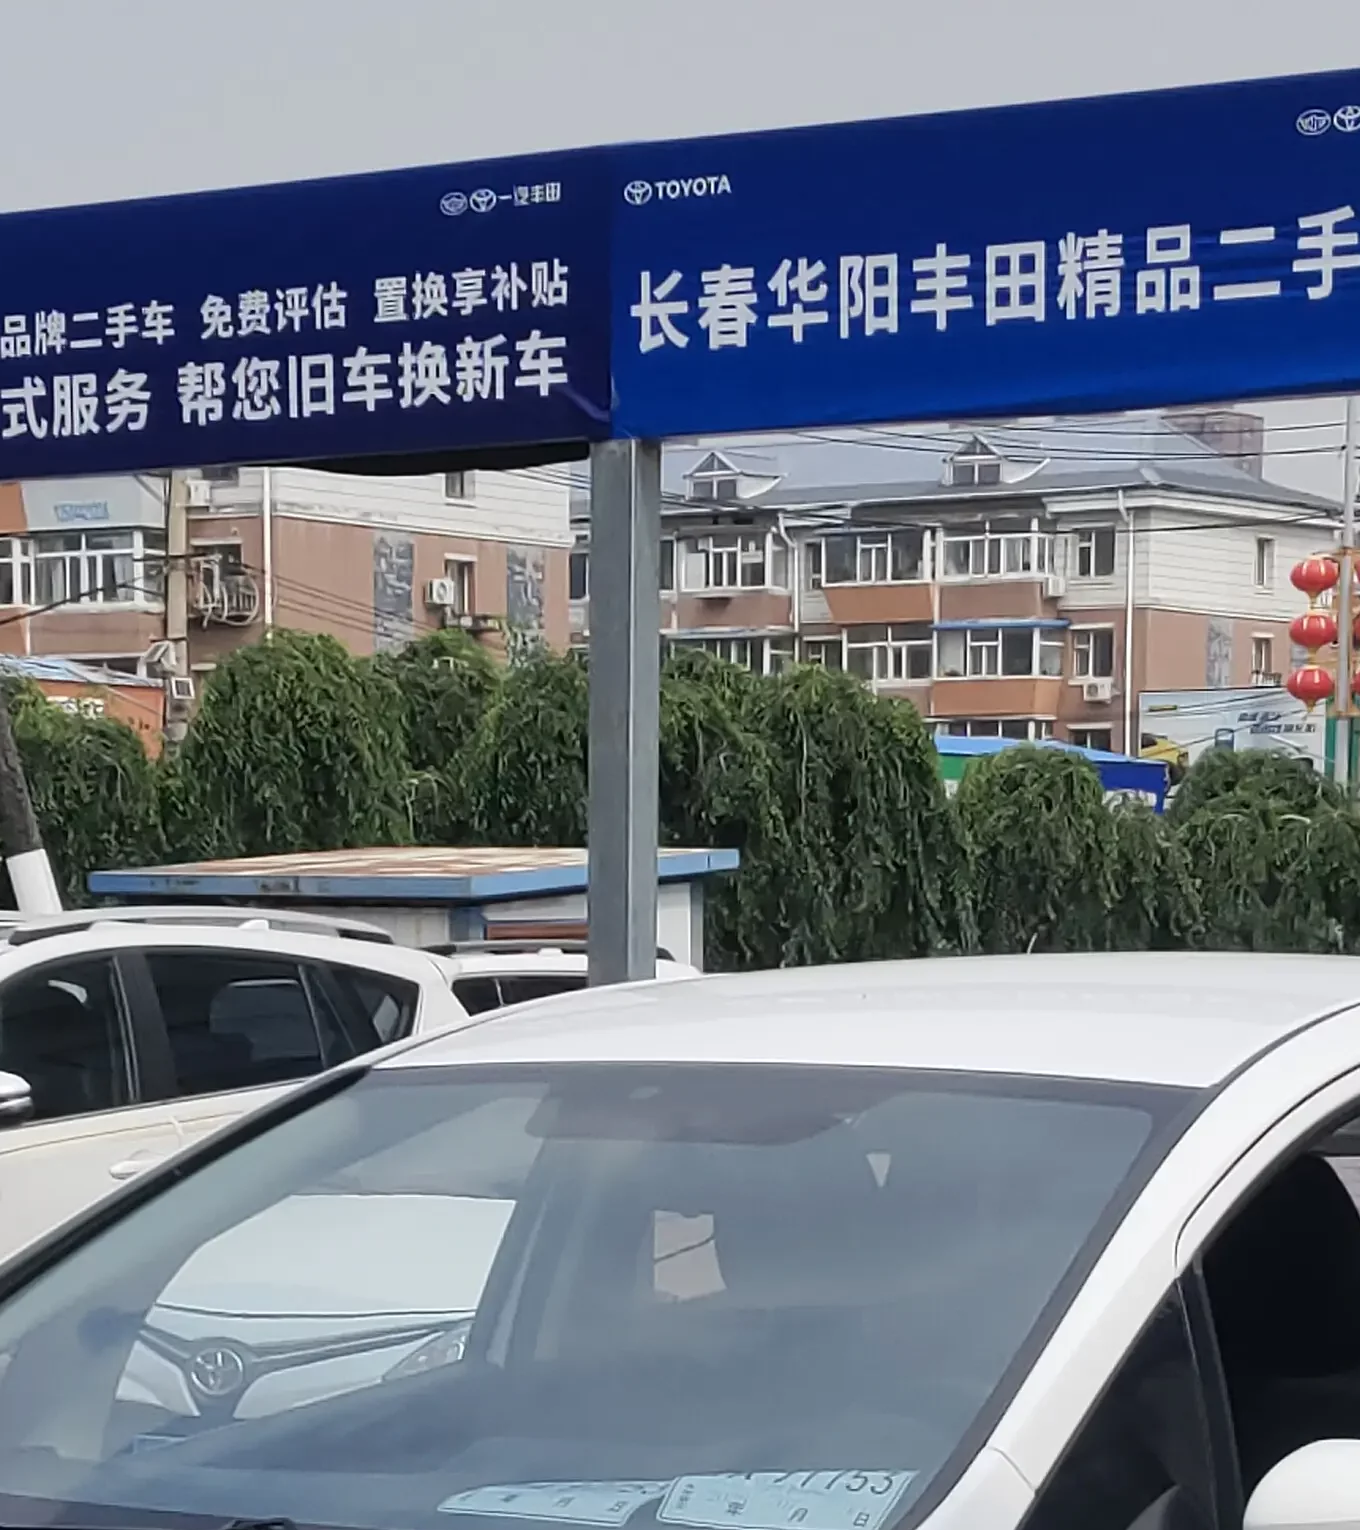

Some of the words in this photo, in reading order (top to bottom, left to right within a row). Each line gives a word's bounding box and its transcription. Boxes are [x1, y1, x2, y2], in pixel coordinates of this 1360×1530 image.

[656, 174, 732, 199] TOYOTA
[200, 284, 348, 341] 免费评估
[374, 259, 570, 323] 置换享补贴
[176, 330, 570, 427] 帮您旧车换新车
